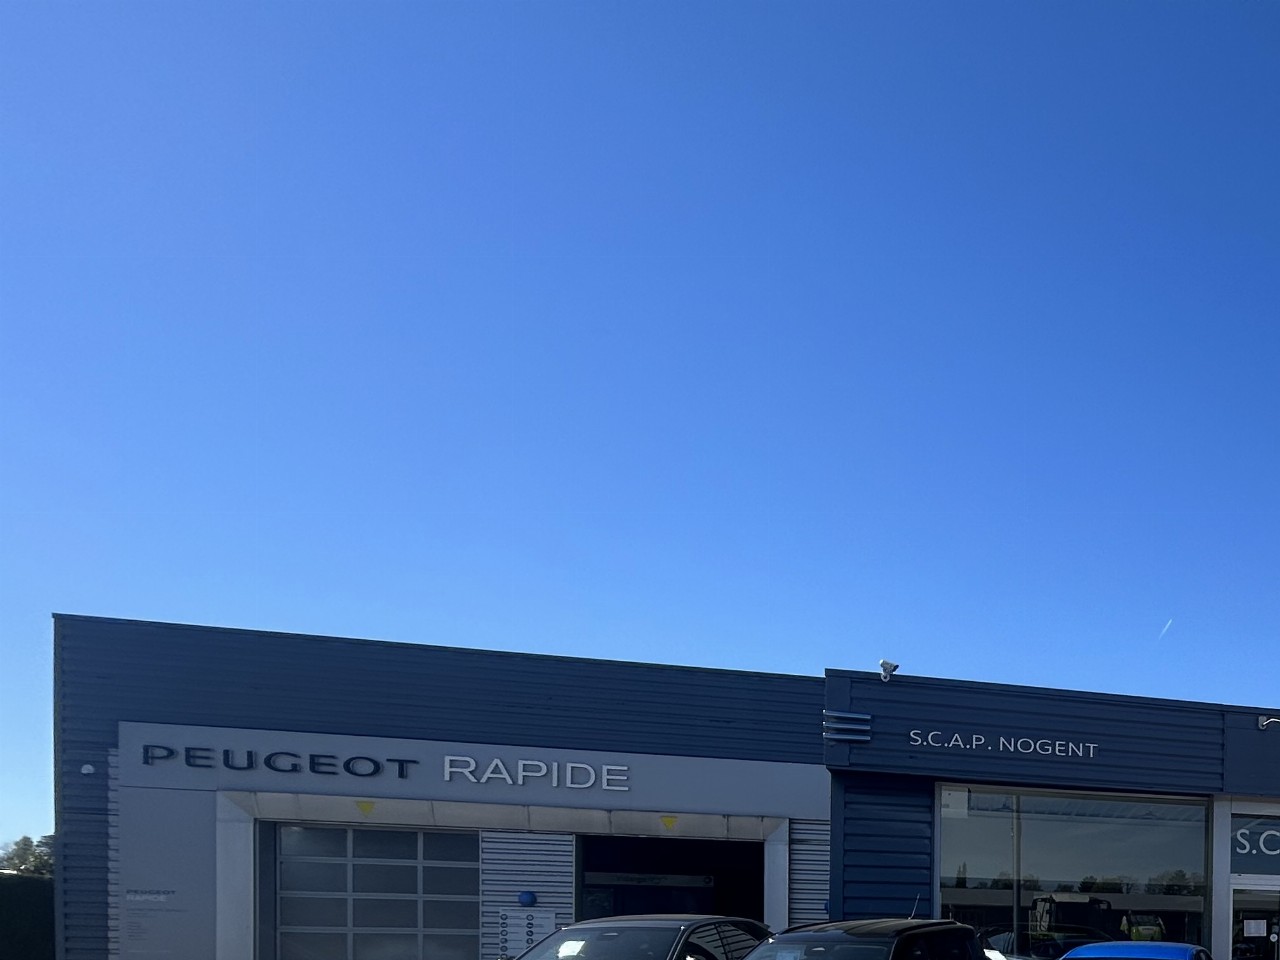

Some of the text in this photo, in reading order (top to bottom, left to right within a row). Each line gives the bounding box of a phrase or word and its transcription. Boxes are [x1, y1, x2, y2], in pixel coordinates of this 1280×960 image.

[910, 730, 1099, 758] S.C.A.P. NOGENT
[142, 745, 630, 791] PEUGEOT RAPIDE
